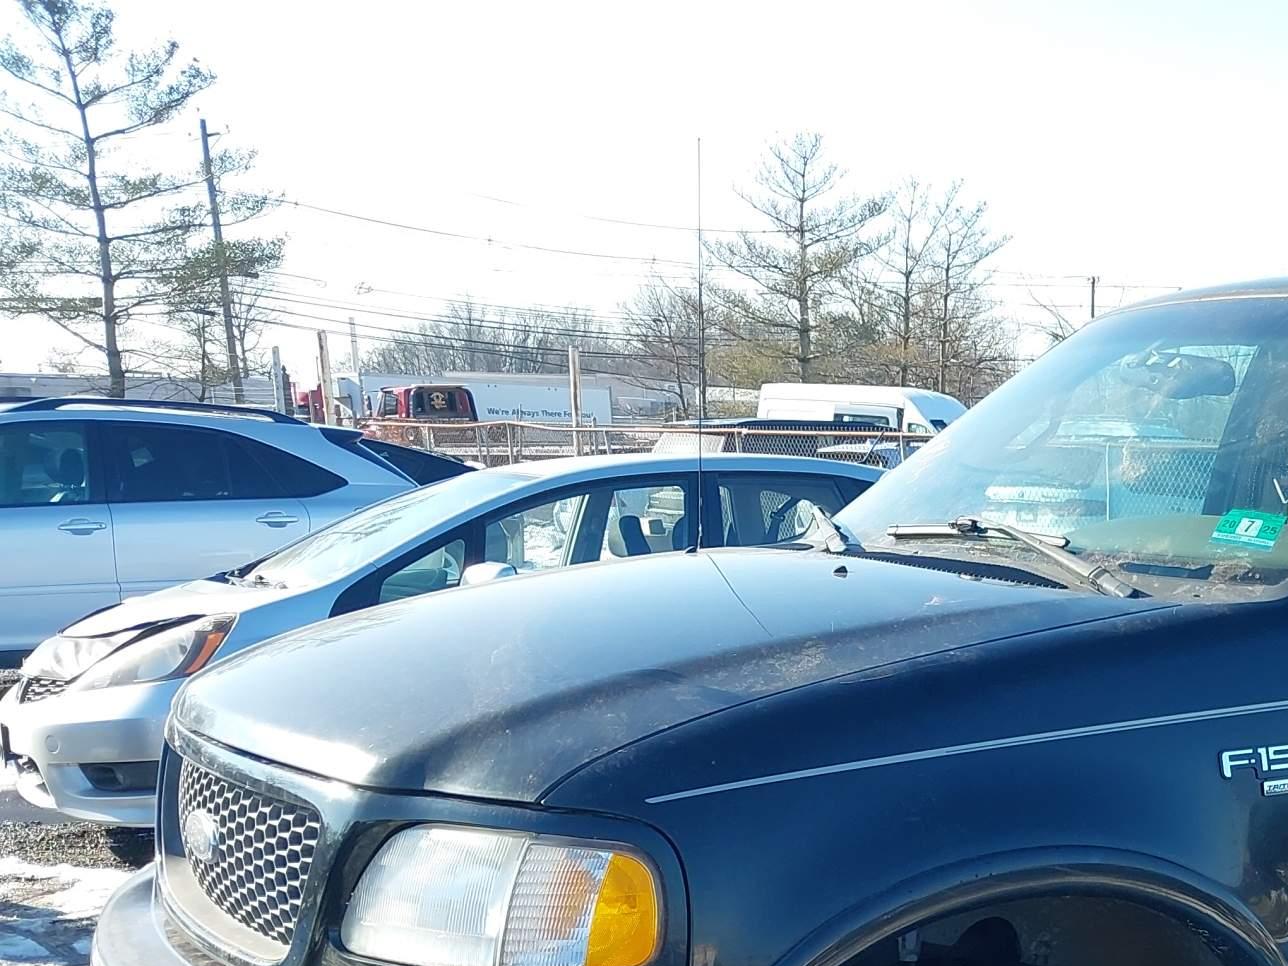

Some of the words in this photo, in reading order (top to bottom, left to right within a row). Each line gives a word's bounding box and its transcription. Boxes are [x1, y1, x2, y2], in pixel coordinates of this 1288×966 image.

[487, 407, 509, 416] We're
[541, 409, 562, 418] There
[1222, 519, 1237, 529] 20
[1244, 519, 1256, 533] 7
[1262, 525, 1278, 535] 25
